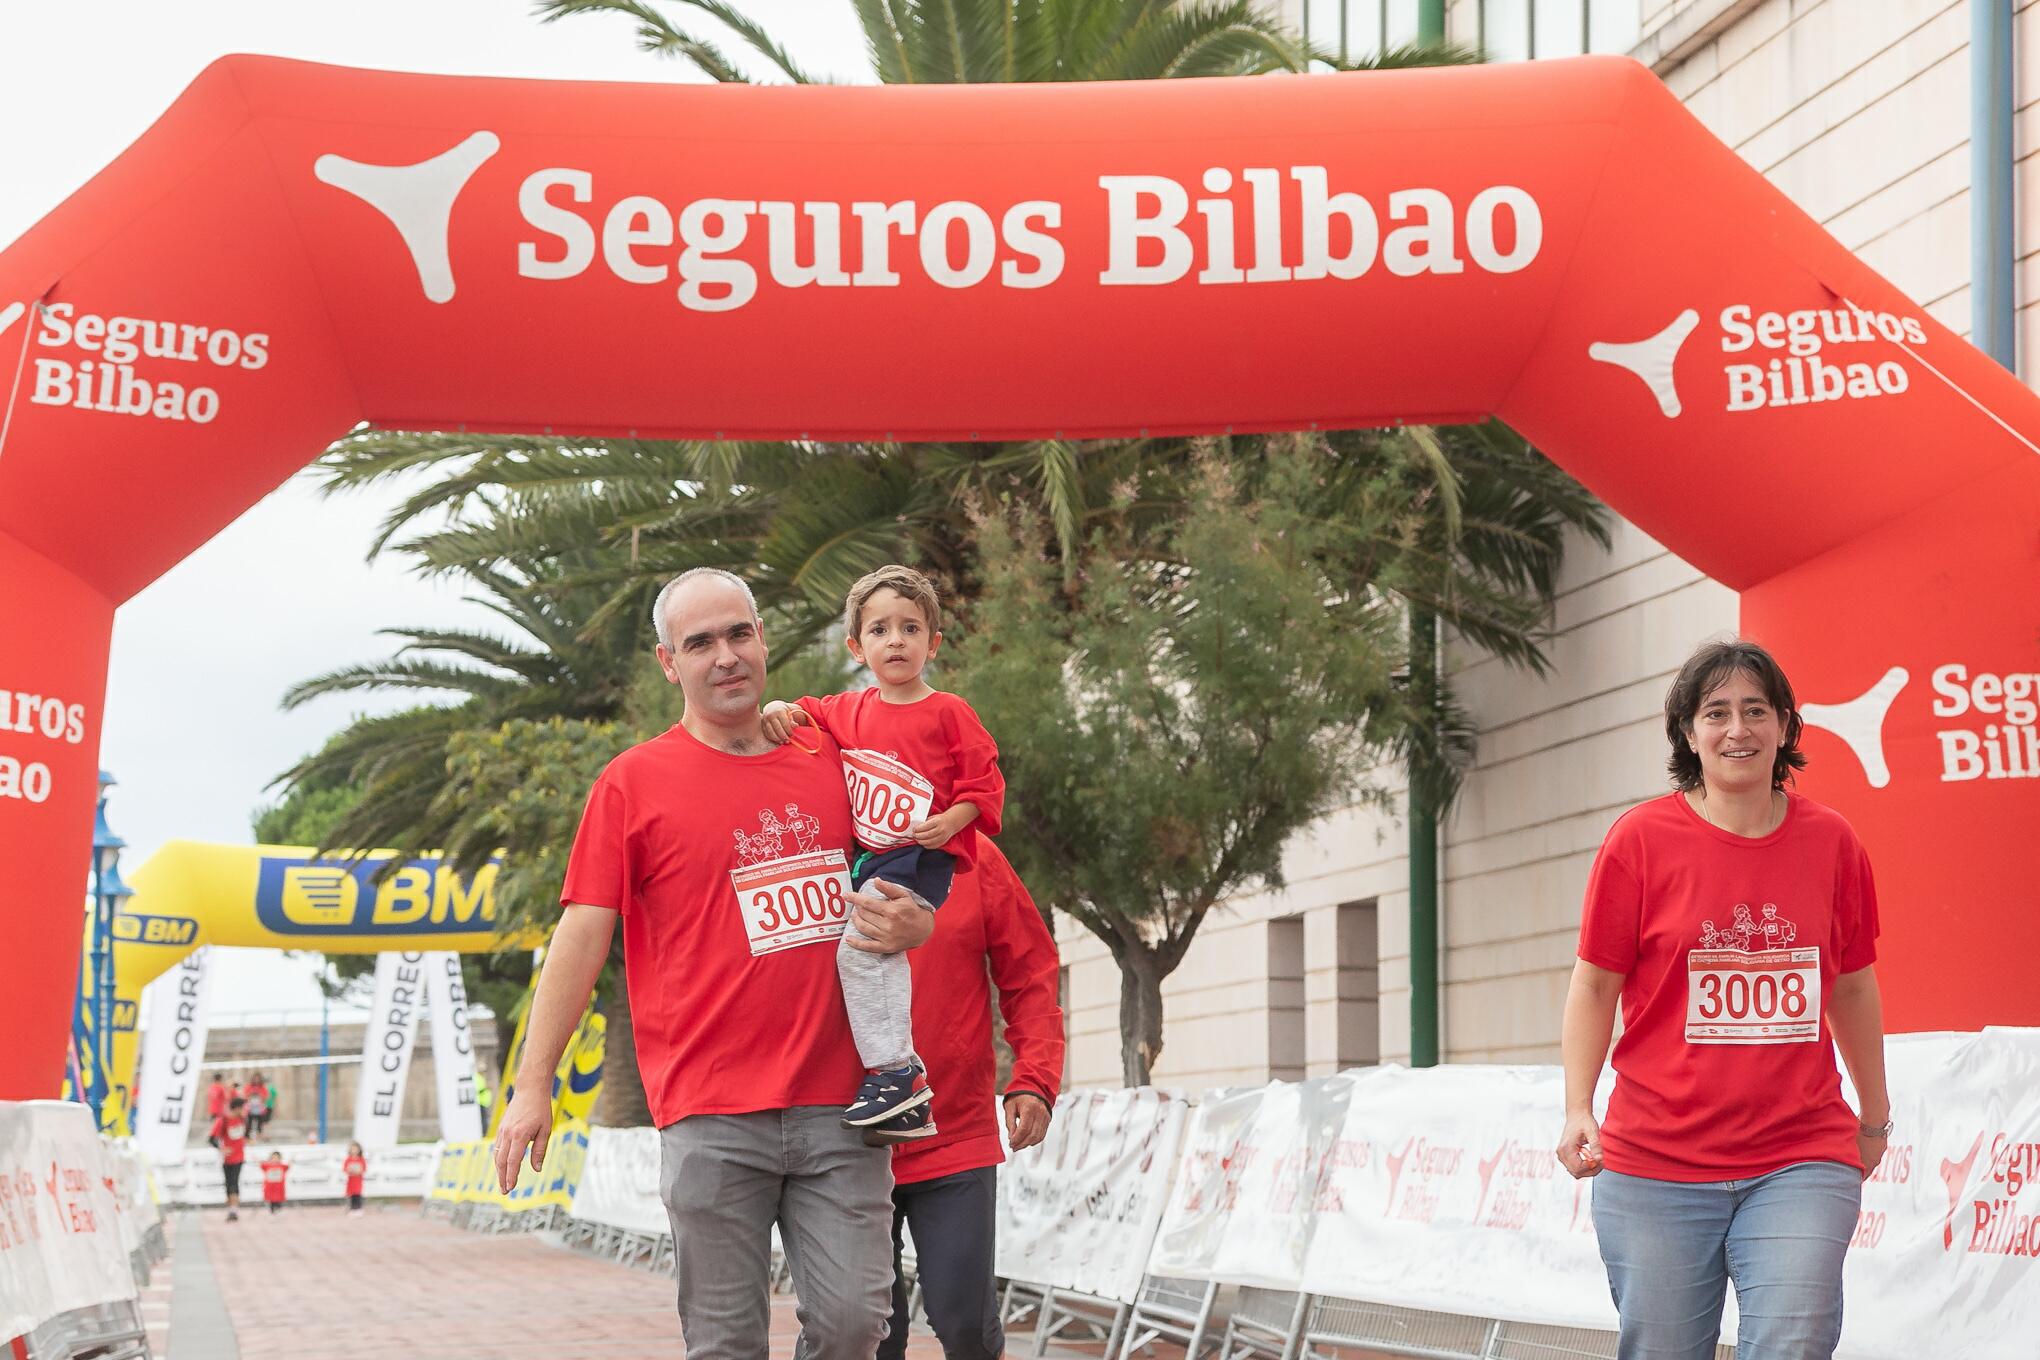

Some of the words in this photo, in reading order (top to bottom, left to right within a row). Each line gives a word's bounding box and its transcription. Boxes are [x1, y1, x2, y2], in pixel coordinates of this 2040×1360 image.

[518, 167, 1065, 312] Seguros
[1099, 166, 1543, 285] Bilbao
[37, 302, 269, 370] Seguros
[1720, 304, 1928, 357] Seguros
[31, 358, 219, 423] Bilbao
[1724, 355, 1909, 411] Bilbao
[1932, 663, 2040, 725] Seg
[847, 769, 915, 833] 3008
[372, 863, 502, 925] BM
[752, 877, 846, 932] 3008
[144, 918, 192, 943] BM
[1698, 972, 1807, 1019] 3008
[160, 1085, 185, 1124] EL
[373, 1081, 397, 1118] EL
